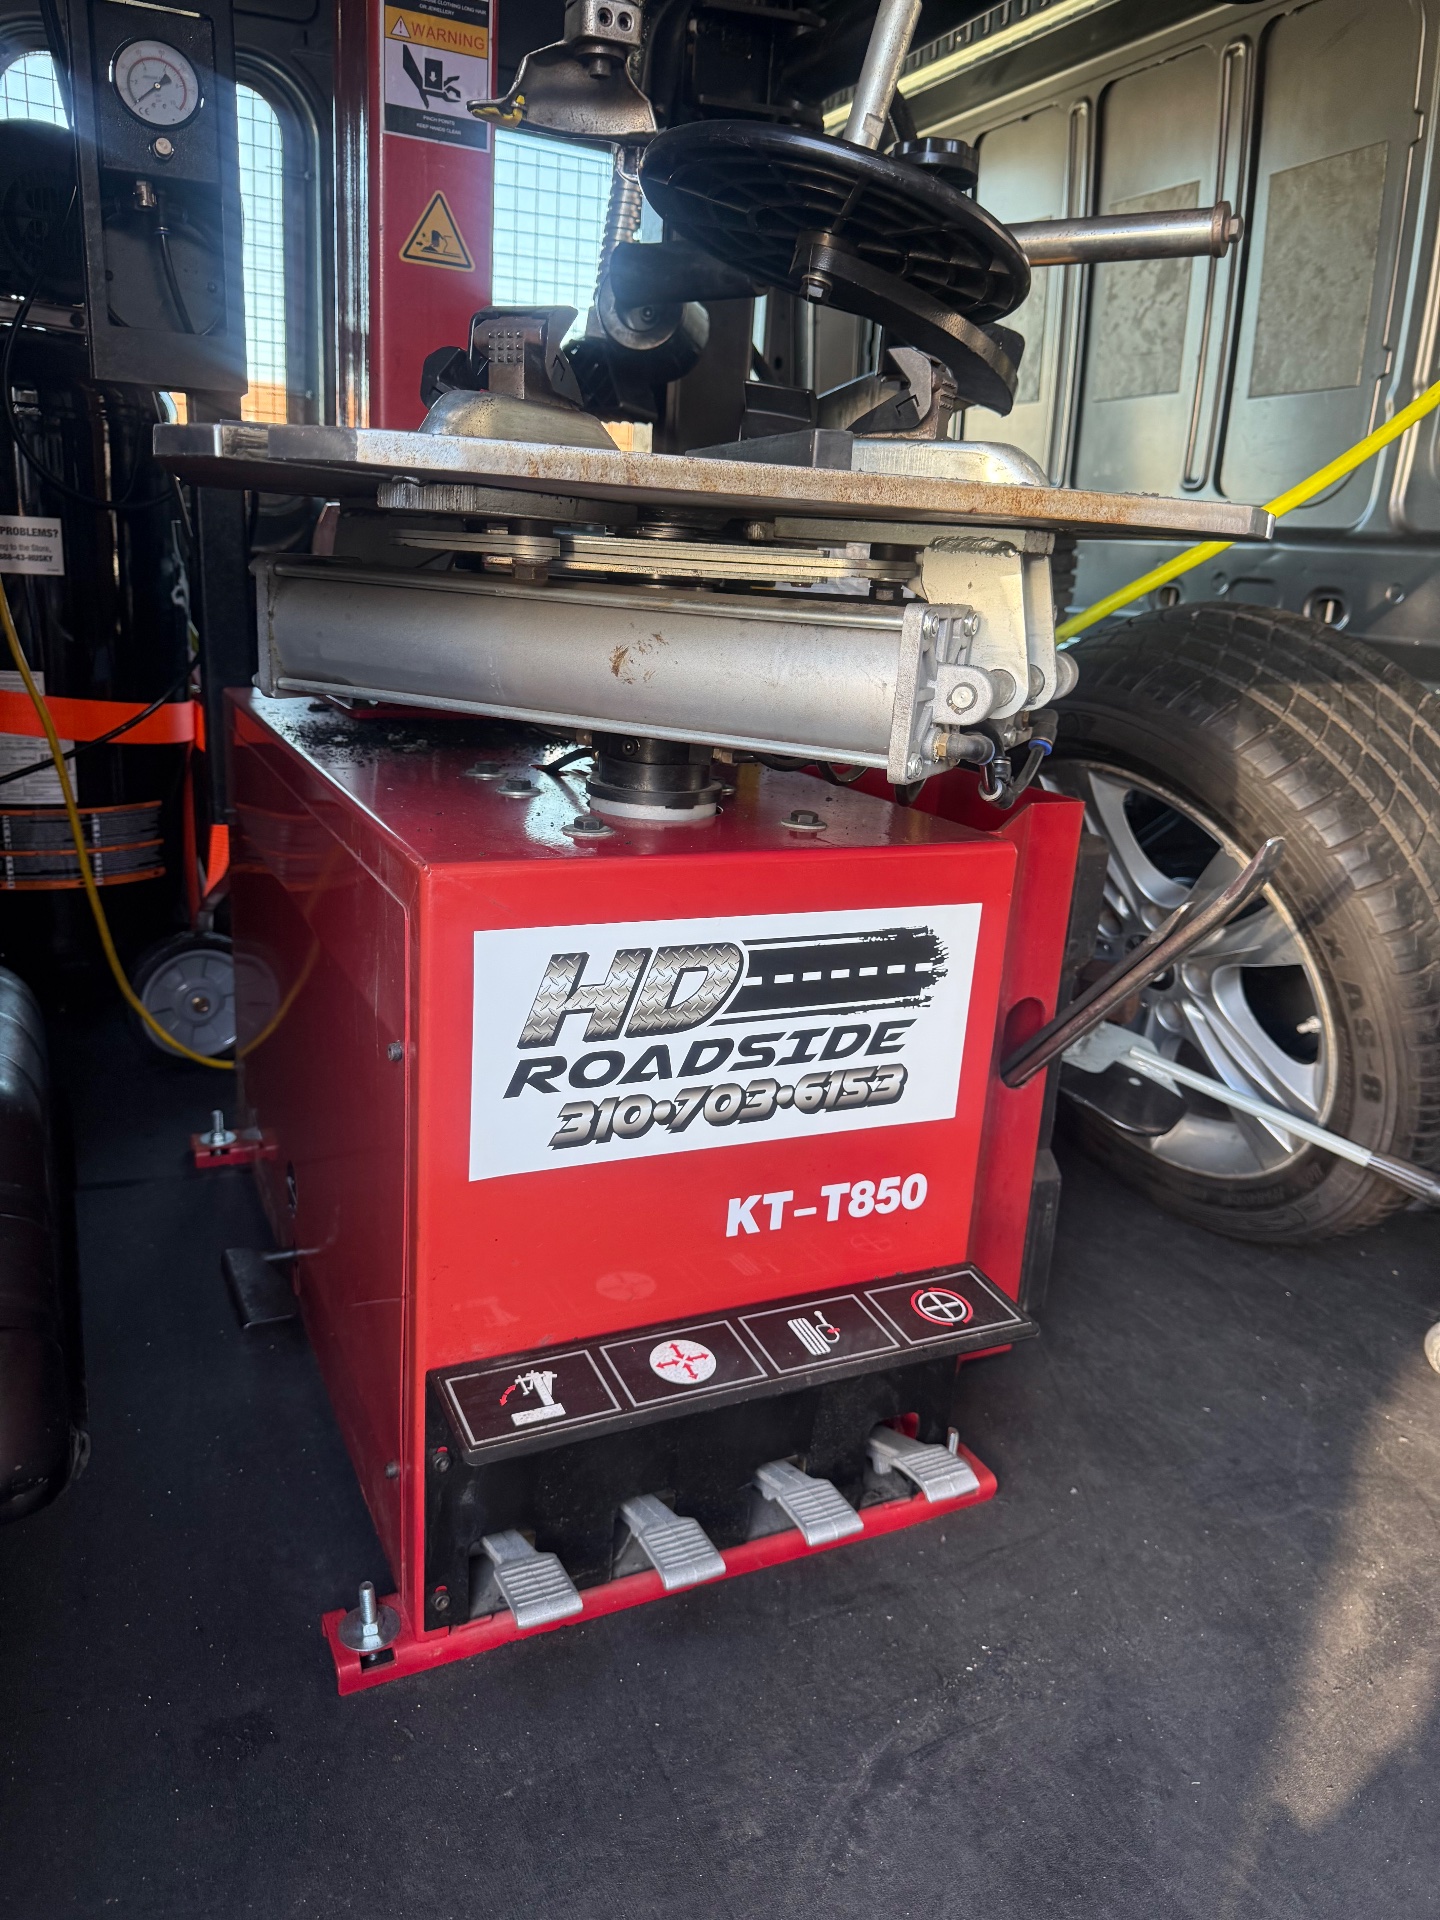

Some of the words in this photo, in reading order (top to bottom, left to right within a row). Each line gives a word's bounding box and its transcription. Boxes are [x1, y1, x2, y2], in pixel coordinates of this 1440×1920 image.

[461, 5, 475, 13] LONG
[411, 22, 485, 50] WARNING
[416, 122, 429, 130] KEEP
[423, 115, 437, 123] PINCH
[438, 118, 456, 127] POINTS
[0, 526, 59, 539] PROBLEMS?
[516, 941, 745, 1050] HD
[502, 1018, 918, 1099] ROADSIDE
[726, 1172, 929, 1238] KT-T850
